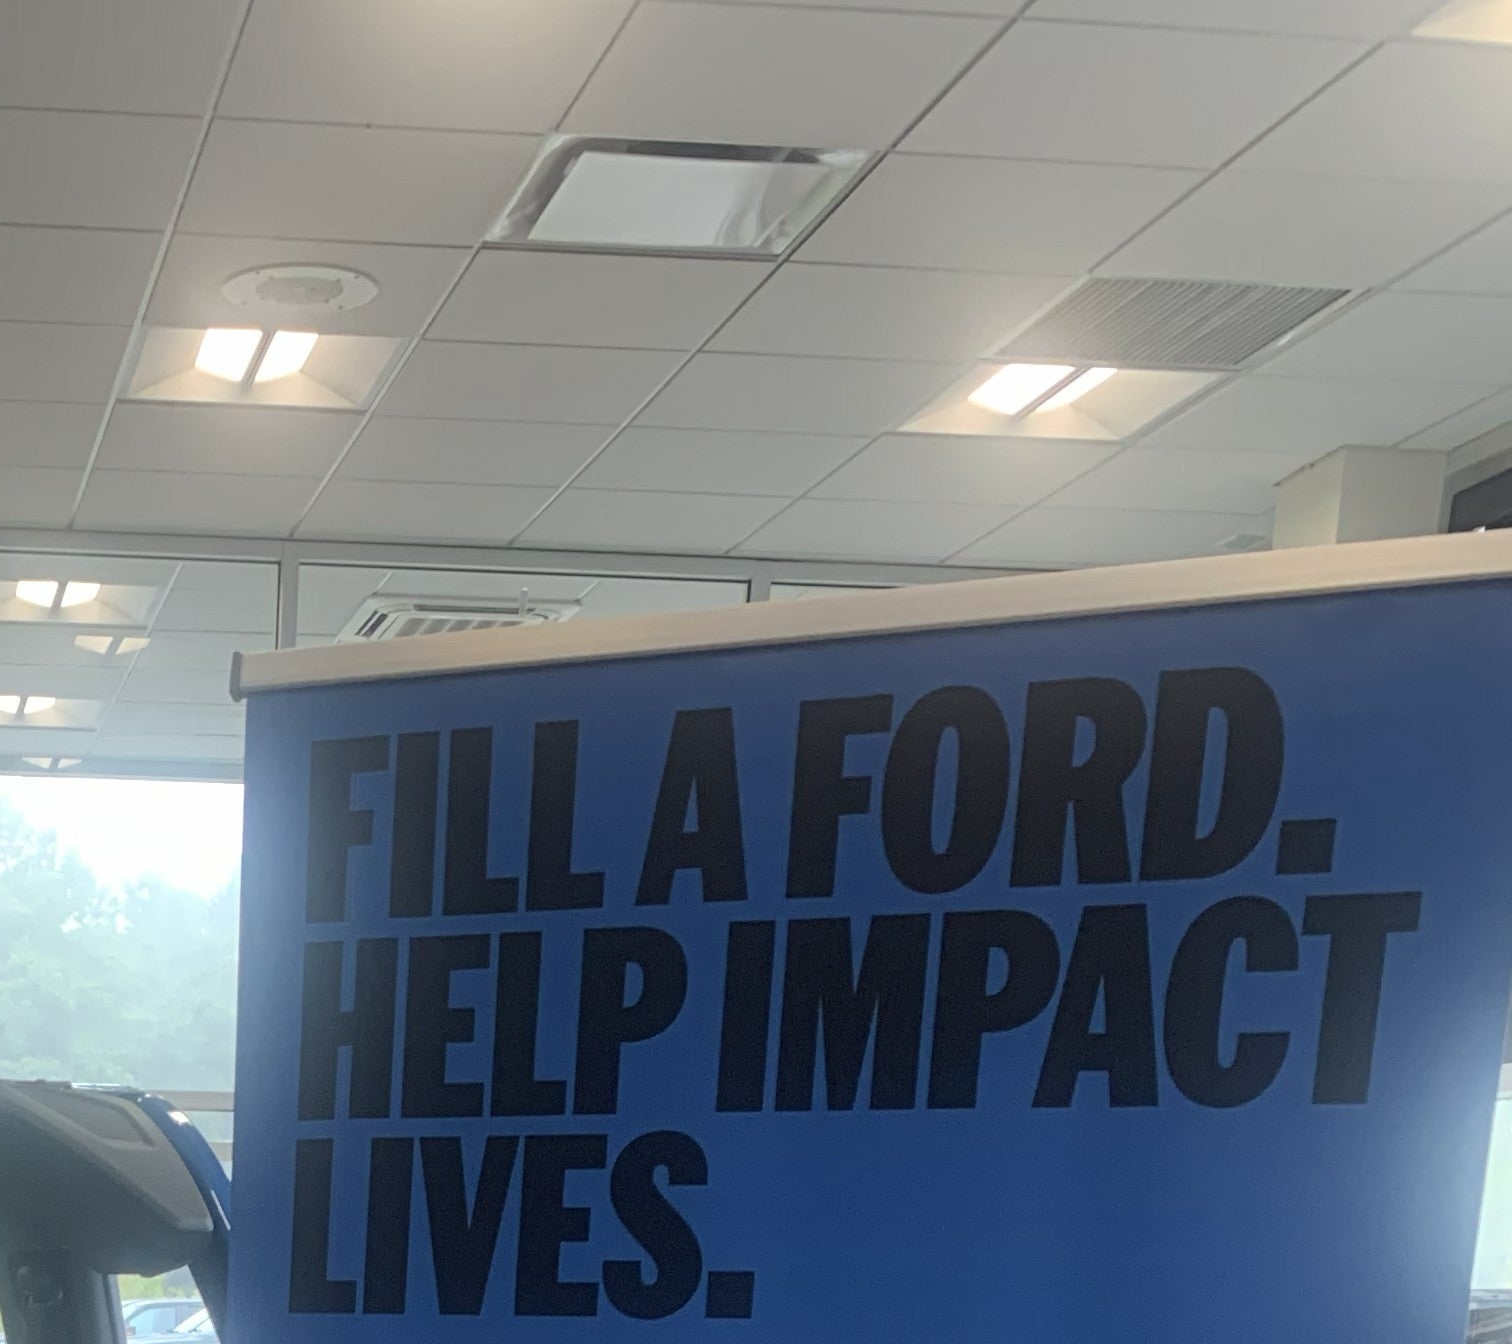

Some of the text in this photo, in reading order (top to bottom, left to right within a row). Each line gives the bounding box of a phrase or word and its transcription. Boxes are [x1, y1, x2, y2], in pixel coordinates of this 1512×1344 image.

[305, 666, 1337, 923] FILL A FORD.
[296, 891, 1423, 1121] HELP IMPACT
[287, 1130, 756, 1321] LIVES.
